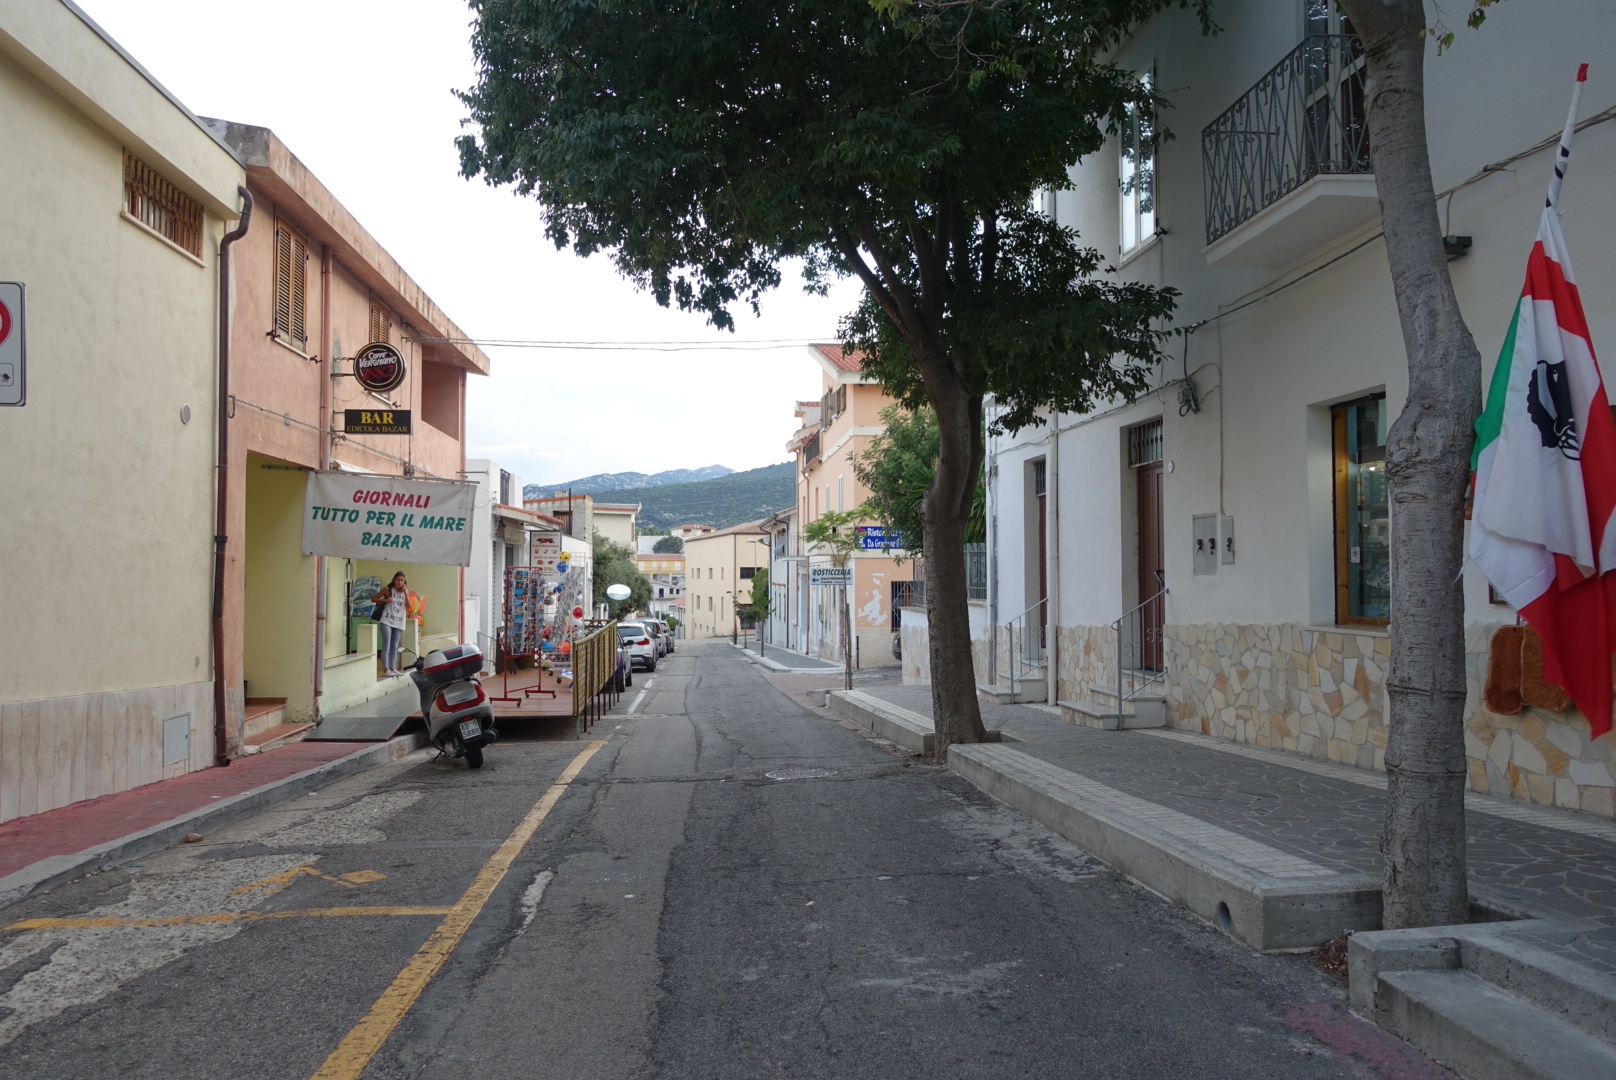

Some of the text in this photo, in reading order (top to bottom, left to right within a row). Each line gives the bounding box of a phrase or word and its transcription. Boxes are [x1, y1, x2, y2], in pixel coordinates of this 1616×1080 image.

[359, 356, 398, 368] VERGNANO
[360, 411, 395, 424] BAR
[352, 489, 431, 509] GIORNALI
[312, 505, 467, 532] TUTTO PER IL MARE
[360, 531, 413, 550] BAZAR
[867, 539, 874, 548] Da
[812, 568, 851, 576] ROSTICCERIA
